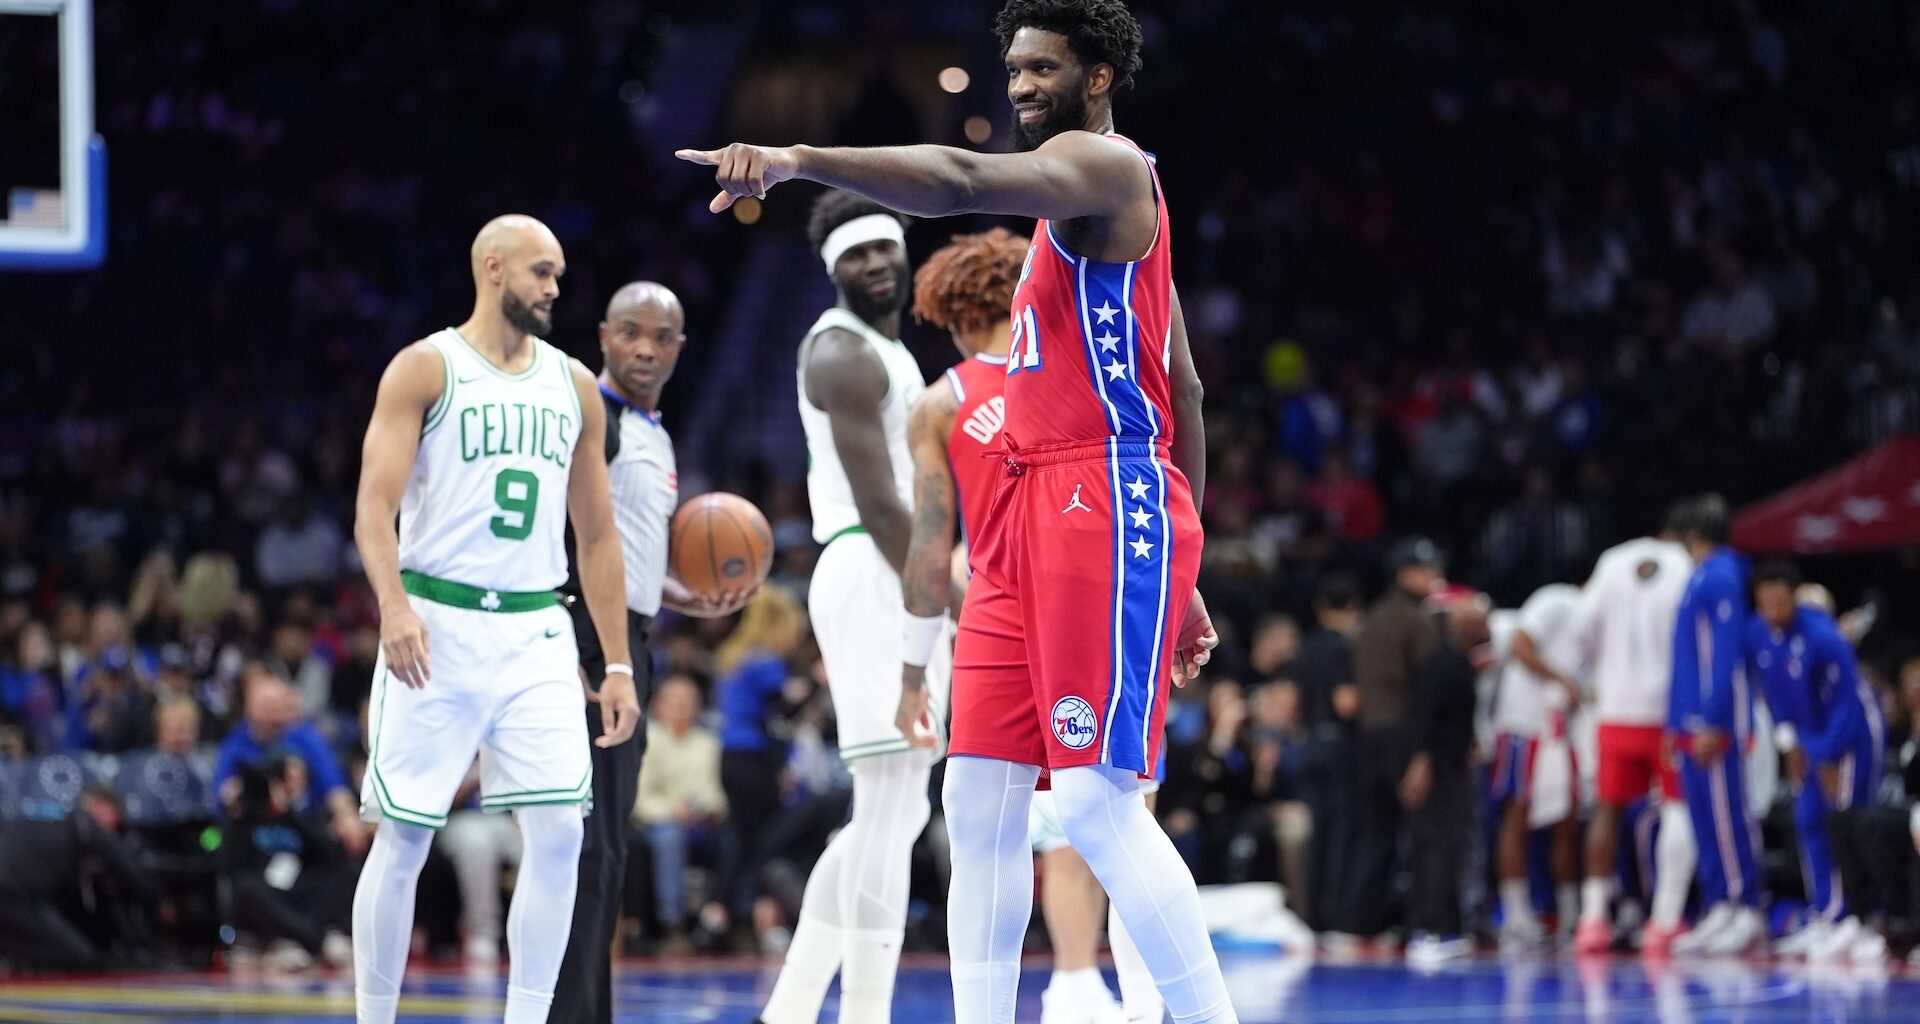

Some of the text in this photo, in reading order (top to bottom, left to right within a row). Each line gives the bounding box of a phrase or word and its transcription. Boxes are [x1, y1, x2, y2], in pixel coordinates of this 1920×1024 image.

[1007, 304, 1042, 376] 21
[460, 403, 572, 469] CELTICS
[489, 468, 540, 541] 9
[1056, 716, 1094, 736] 76ers
